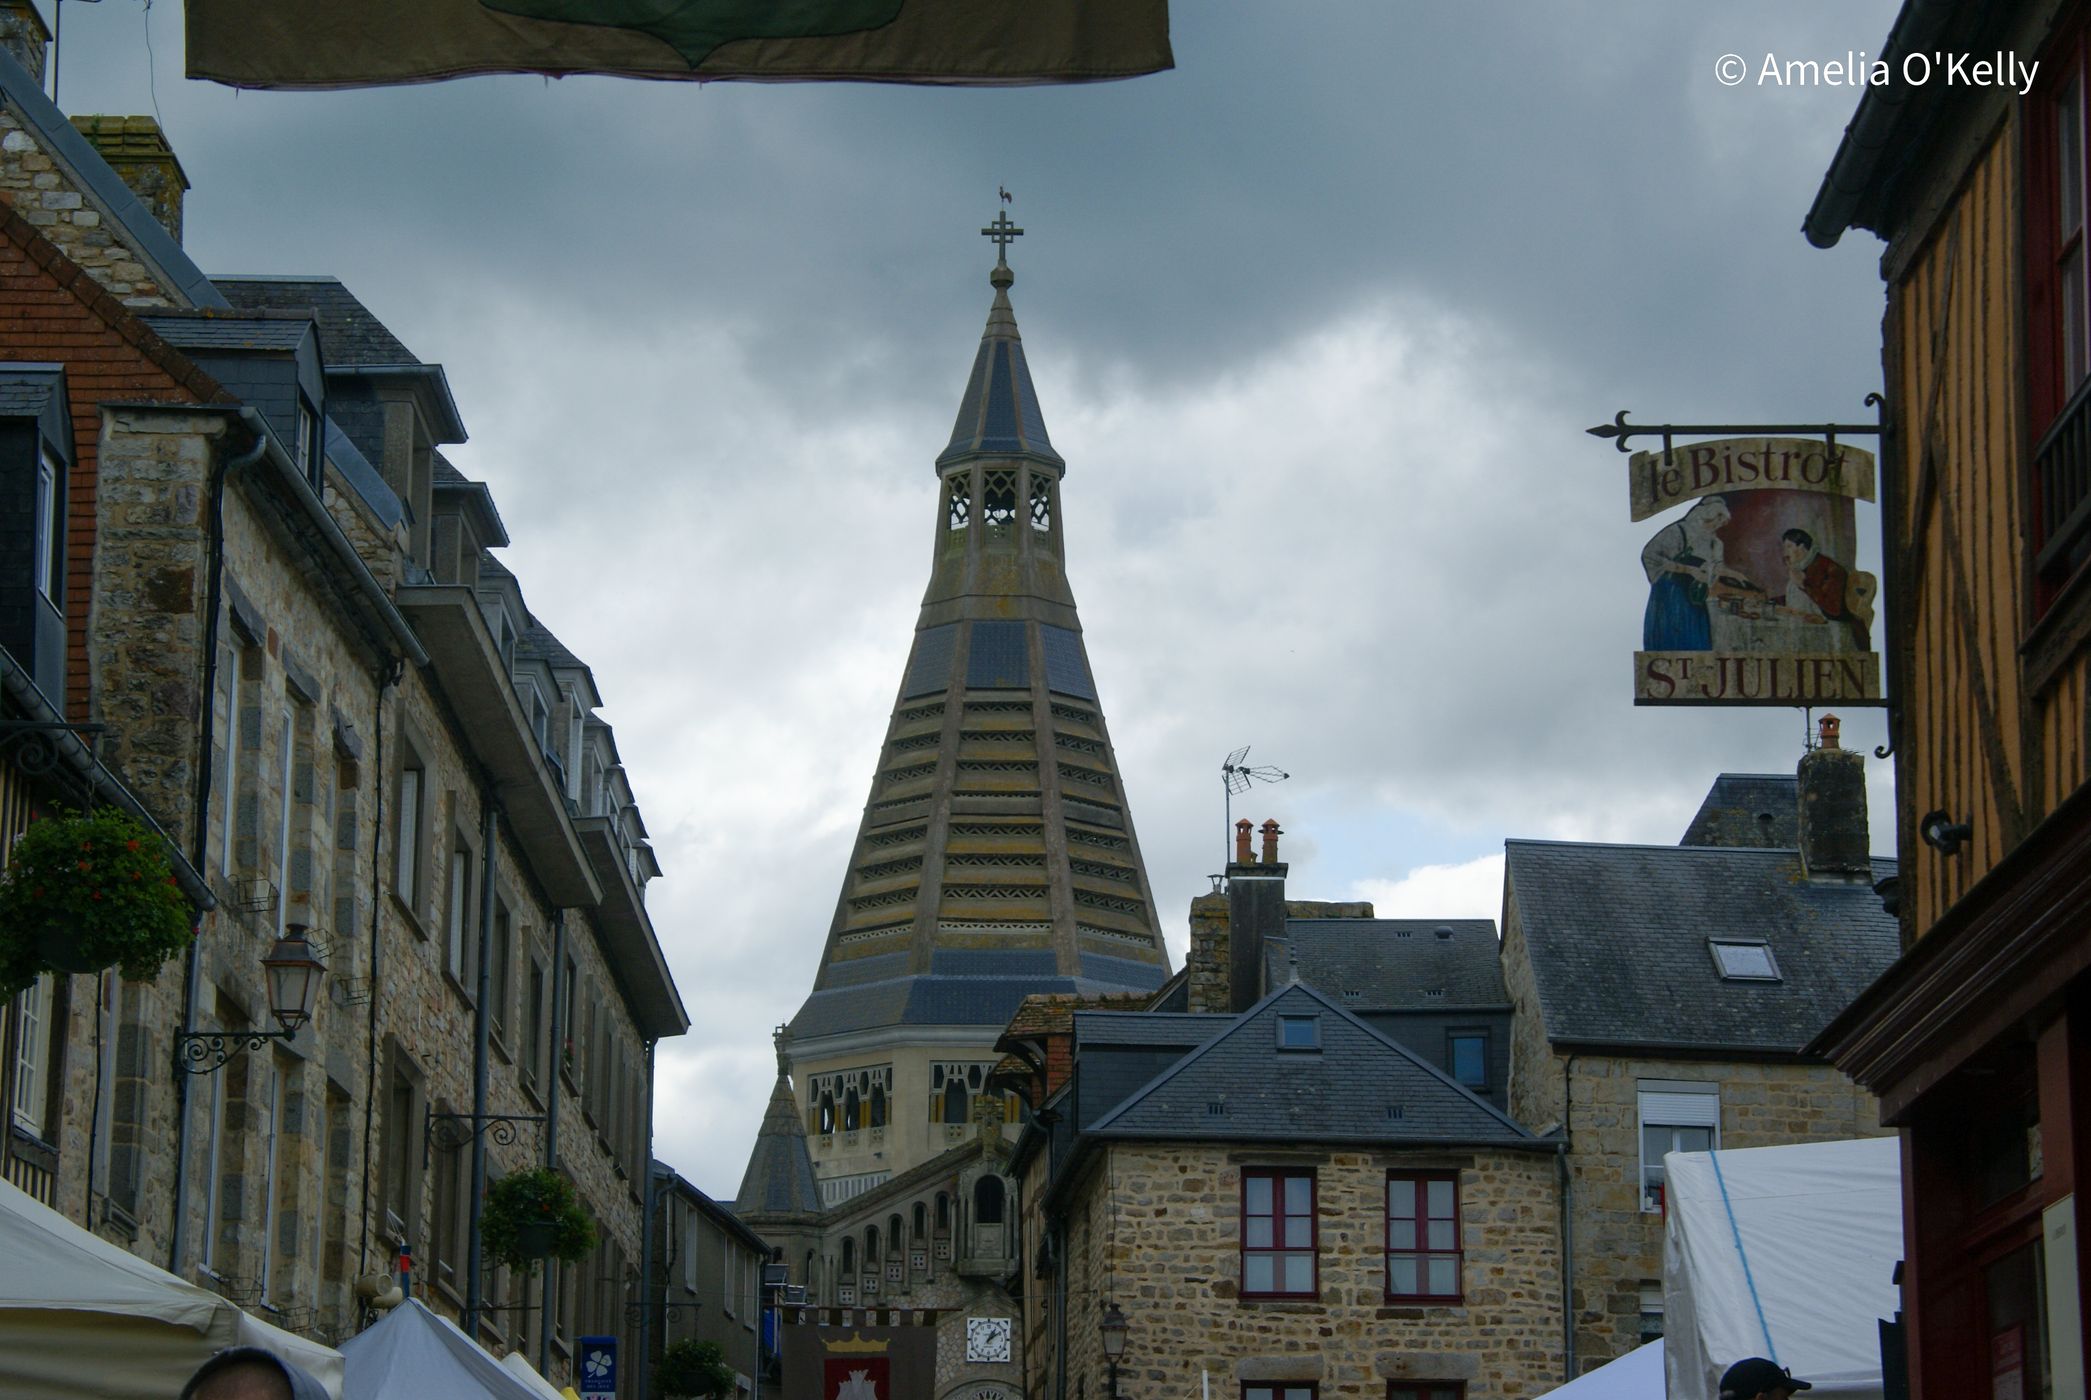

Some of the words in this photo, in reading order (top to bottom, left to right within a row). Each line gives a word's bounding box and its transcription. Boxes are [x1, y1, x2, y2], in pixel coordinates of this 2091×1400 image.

[1649, 458, 1682, 503] le
[1689, 442, 1849, 491] Bistrot
[1701, 658, 1866, 700] JULIEN
